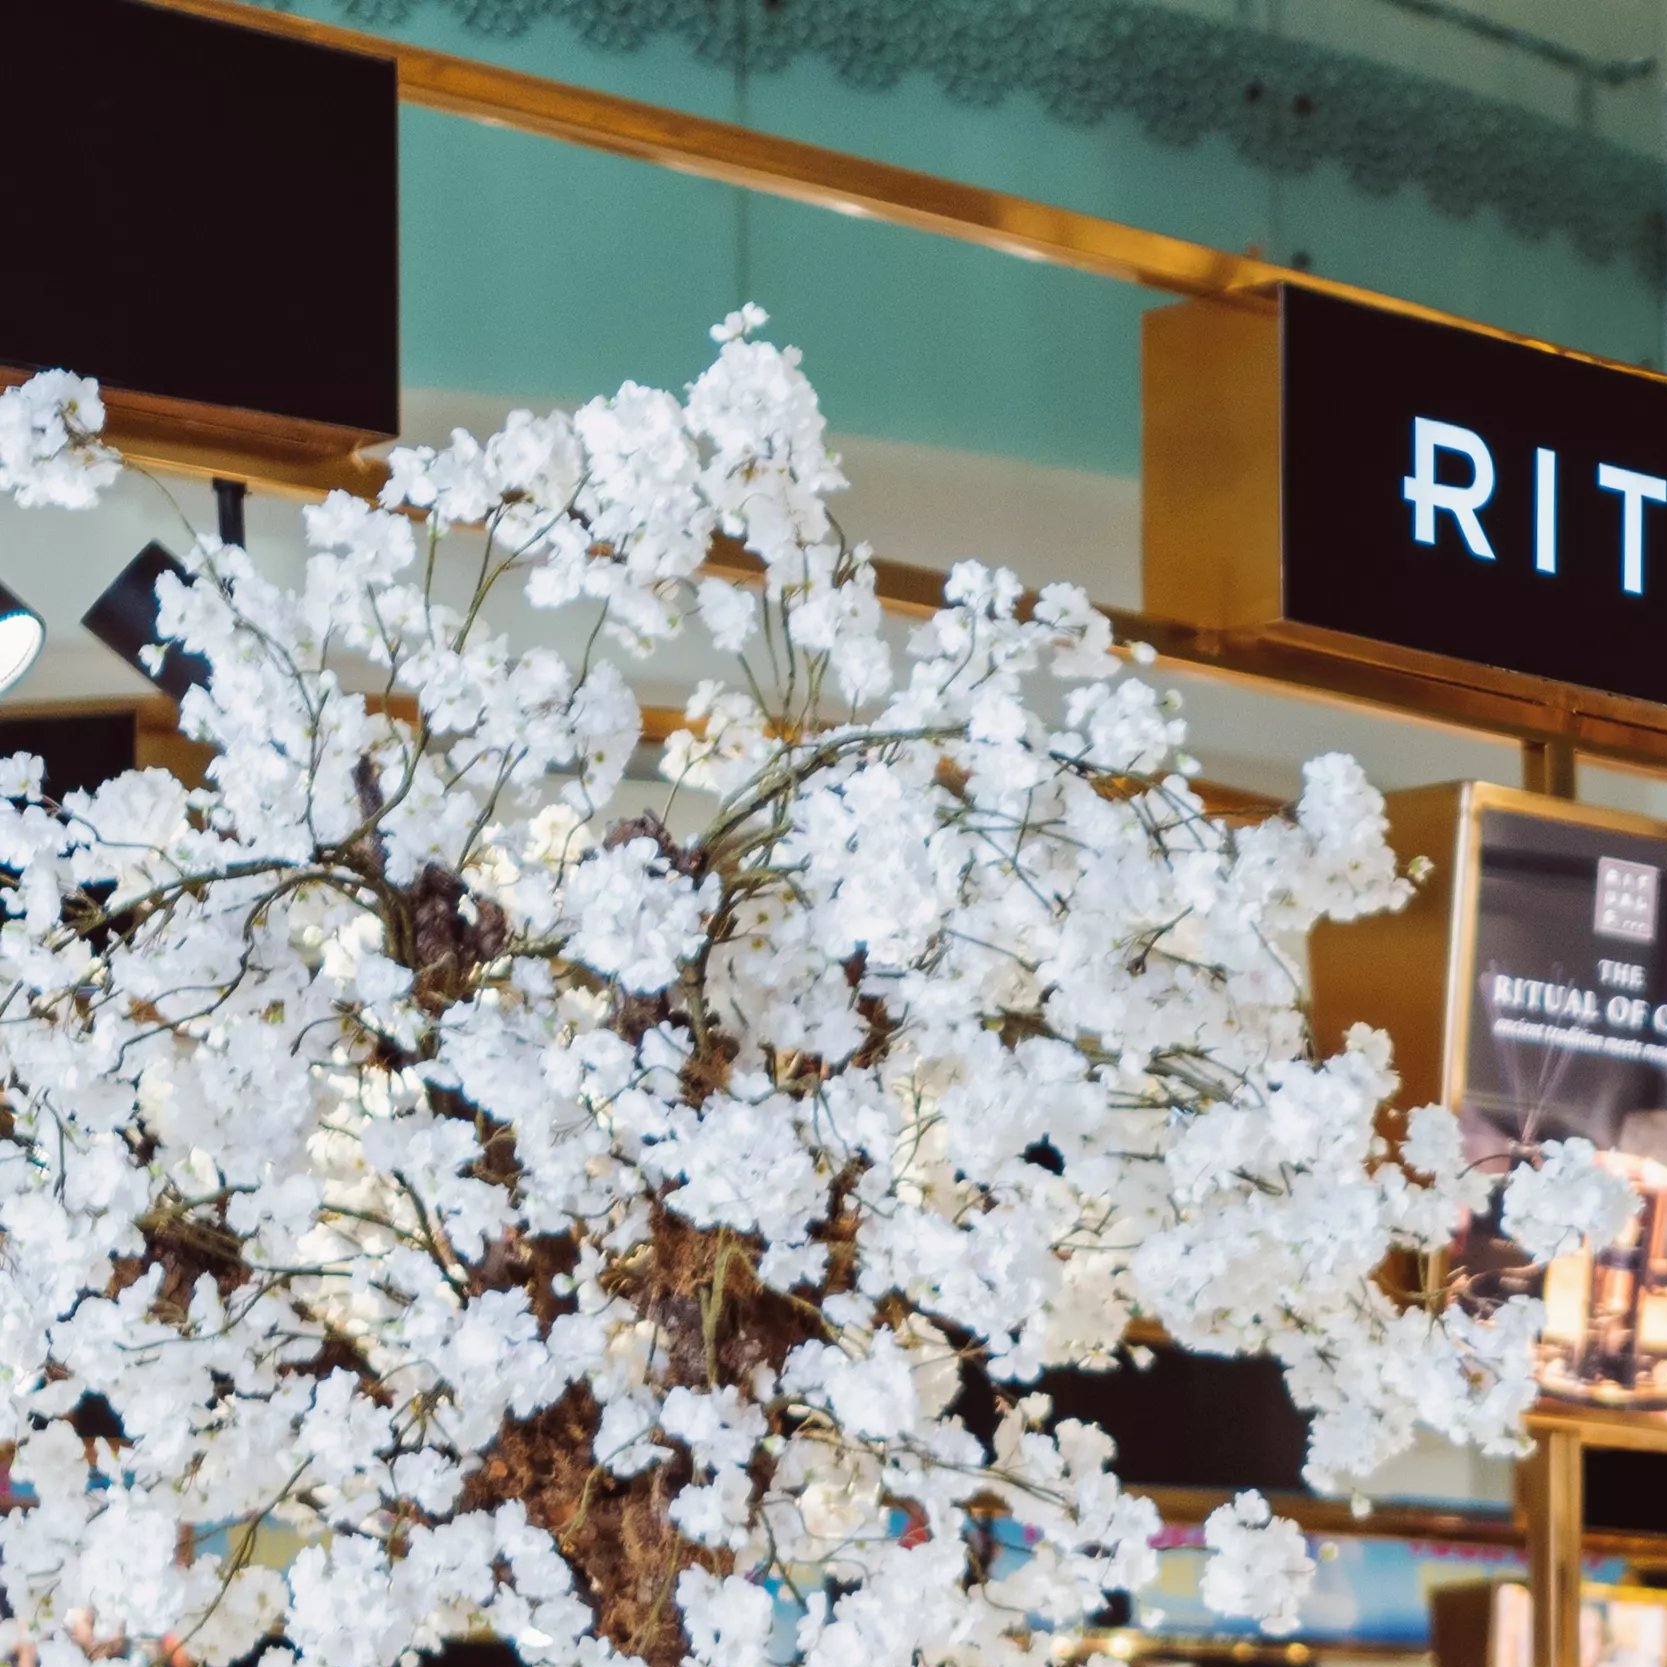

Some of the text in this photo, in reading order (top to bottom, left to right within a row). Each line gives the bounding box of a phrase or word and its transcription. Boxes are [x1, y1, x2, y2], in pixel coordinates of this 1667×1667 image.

[1598, 959, 1646, 989] THE
[1493, 974, 1599, 1022] RITUAL
[1607, 996, 1648, 1030] OF
